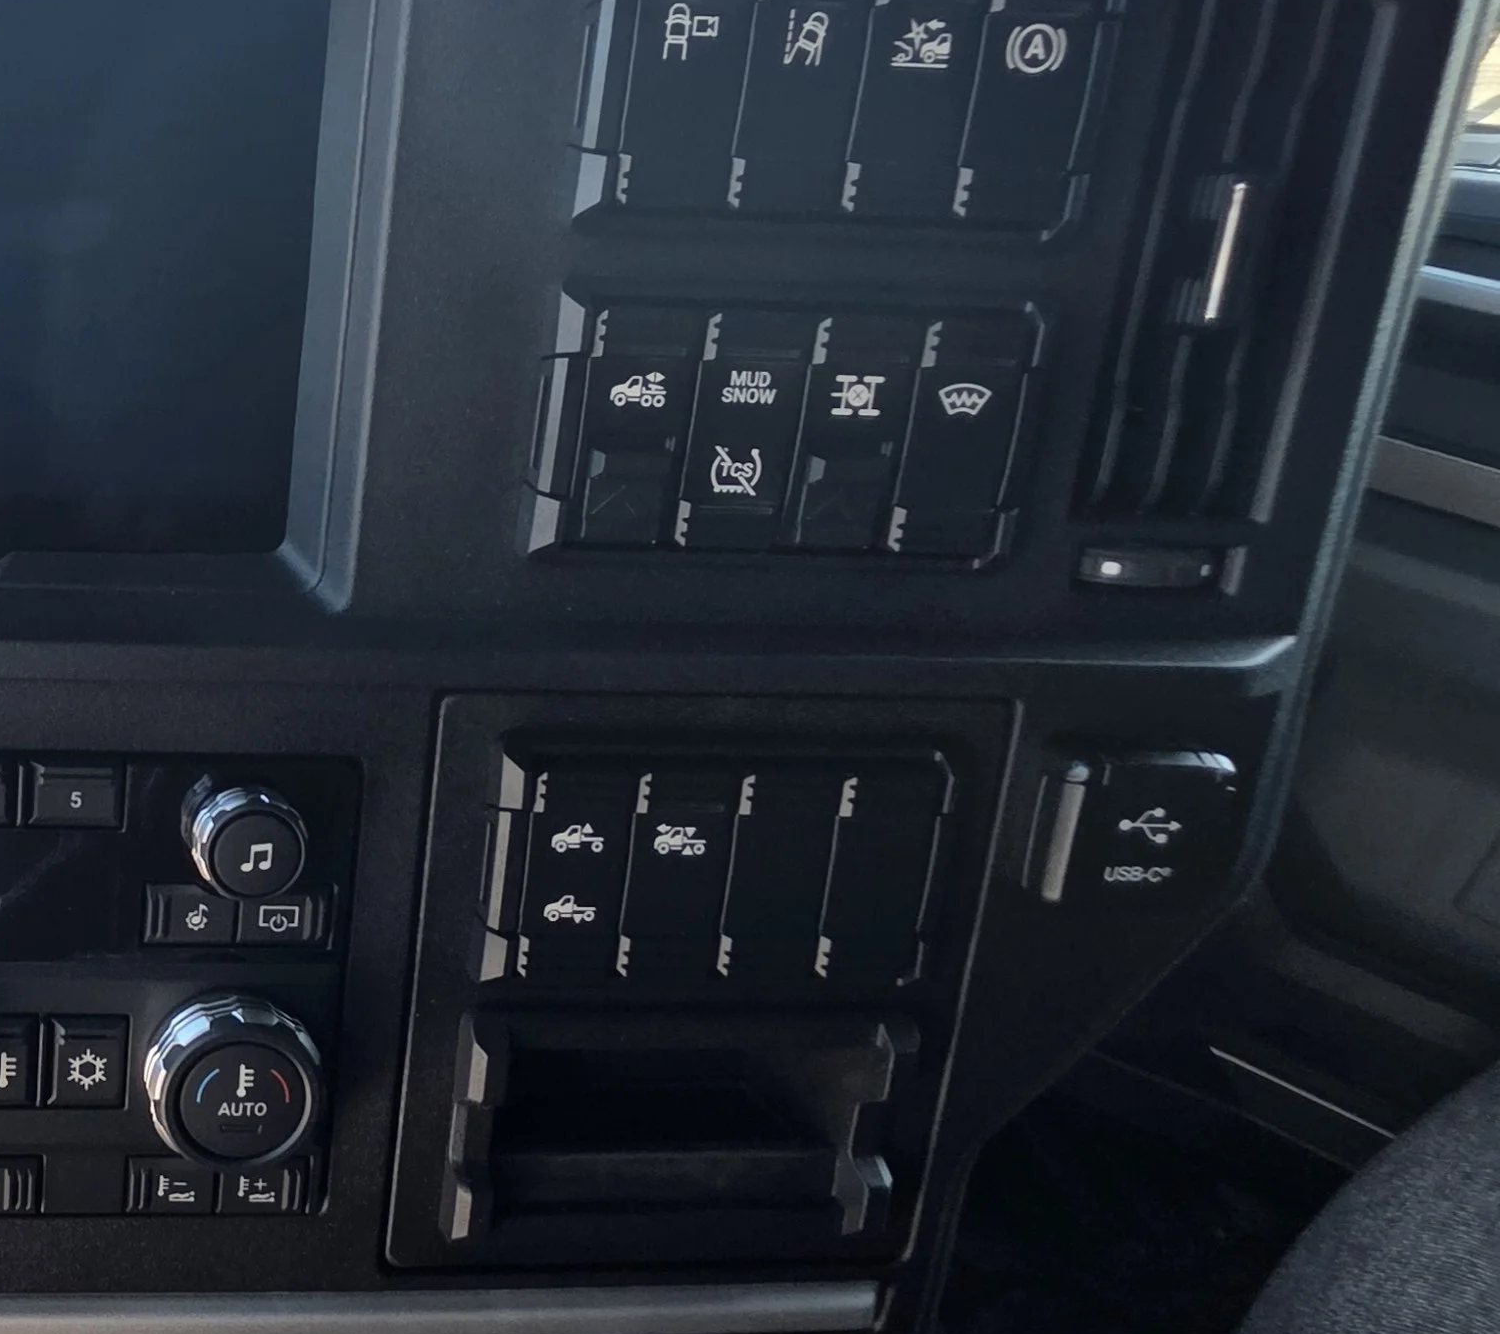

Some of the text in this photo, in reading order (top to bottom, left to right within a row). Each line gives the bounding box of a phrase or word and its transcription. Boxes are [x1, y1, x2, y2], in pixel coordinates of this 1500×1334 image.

[730, 370, 772, 387] MUD
[721, 387, 777, 404] SNOW
[720, 461, 755, 478] TCS
[69, 791, 82, 809] 5
[217, 1101, 268, 1117] AUTO
